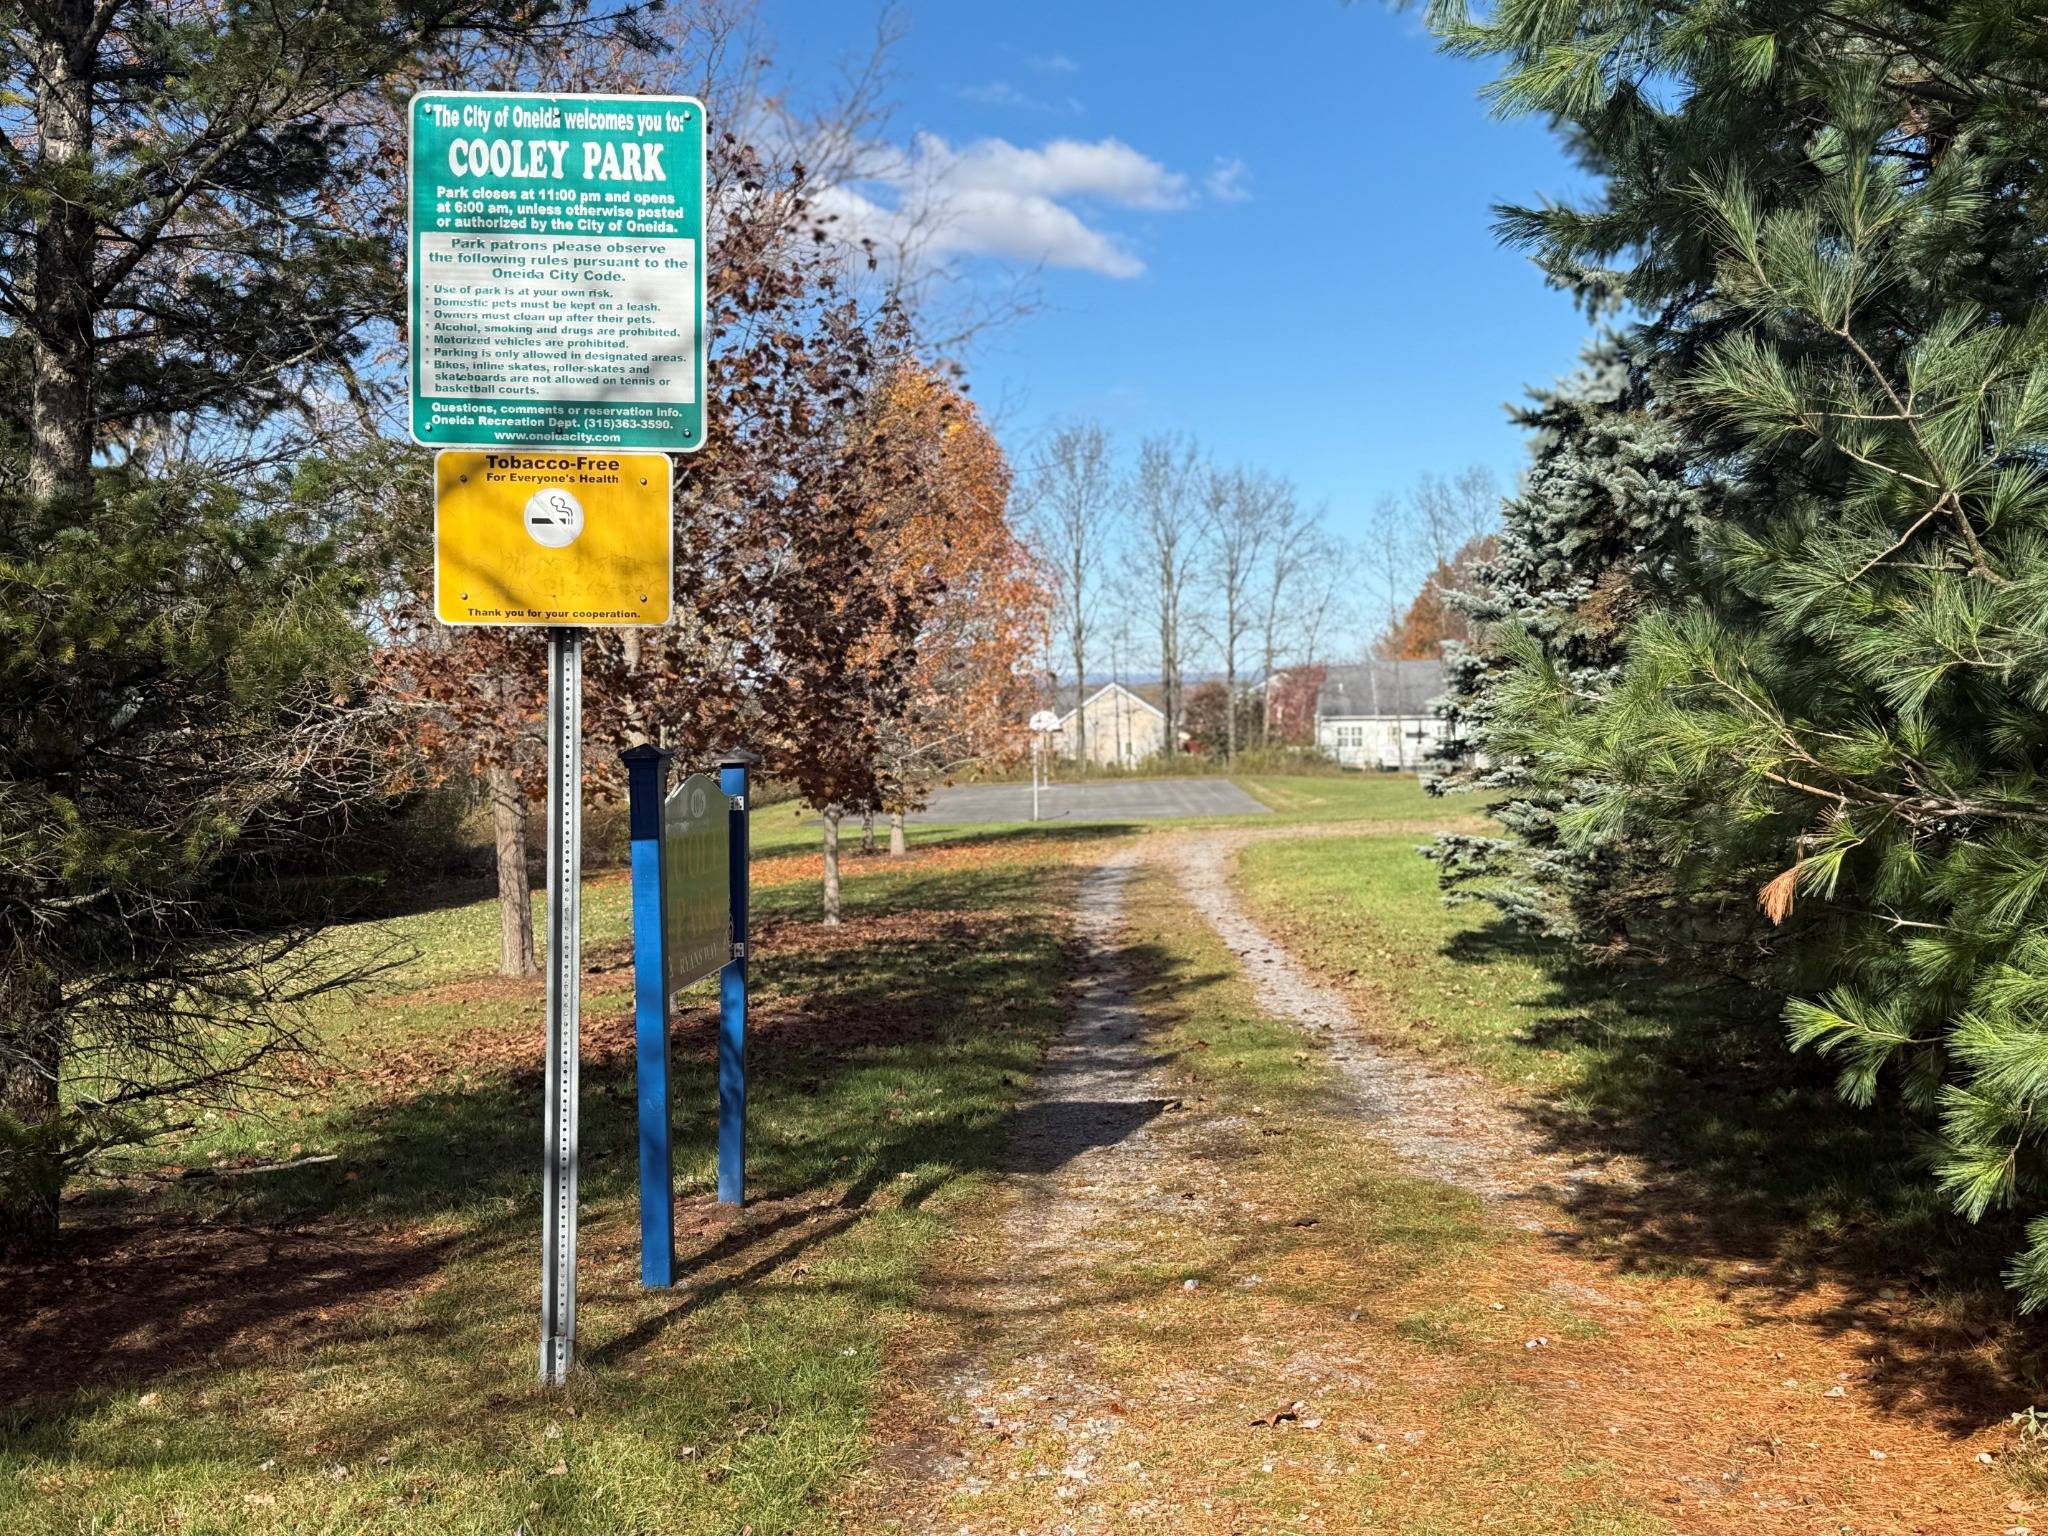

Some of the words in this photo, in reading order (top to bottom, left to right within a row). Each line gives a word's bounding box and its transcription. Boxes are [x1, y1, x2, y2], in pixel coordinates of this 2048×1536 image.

[433, 105, 459, 126] The
[463, 106, 489, 132] City
[495, 106, 508, 127] of
[565, 109, 633, 131] welcomes
[637, 113, 661, 136] you
[666, 111, 684, 132] to:
[449, 138, 570, 179] COOLEY
[583, 142, 667, 181] PARK
[436, 186, 468, 198] Park
[472, 187, 516, 200] closes
[521, 189, 535, 200] at
[539, 189, 576, 201] 11:00
[580, 192, 600, 204] pm
[605, 191, 630, 202] and
[634, 193, 675, 206] opens
[436, 202, 451, 212] at
[455, 202, 483, 213] 6:00
[488, 205, 513, 215] am,
[517, 204, 561, 215] unless
[565, 204, 633, 217] otherwise
[637, 207, 684, 220] posted
[436, 218, 451, 227] or
[455, 216, 526, 229] authorized
[530, 217, 547, 231] by
[551, 218, 574, 230] the
[577, 219, 604, 233] City
[608, 219, 622, 231] of
[626, 220, 678, 233] Oneida.
[451, 238, 485, 249] Park
[491, 241, 548, 252] patrons
[553, 241, 601, 253] please
[607, 242, 666, 253] observe
[429, 252, 453, 263] the
[457, 253, 527, 267] following
[531, 254, 568, 265] rules
[573, 257, 640, 270] pursuant
[645, 257, 659, 268] to
[663, 258, 688, 269] the
[492, 268, 545, 279] Oneida
[550, 269, 579, 282] City
[583, 270, 626, 282] Code.
[434, 285, 456, 294] Use
[460, 286, 471, 294] of
[475, 286, 500, 297] park
[505, 288, 515, 296] is
[533, 289, 557, 298] your
[589, 289, 613, 298] risk.
[434, 298, 488, 307] Domestic
[492, 300, 517, 309] pets
[521, 300, 549, 308] must
[553, 301, 566, 309] be
[570, 301, 595, 311] kept
[627, 302, 661, 311] leash.
[434, 310, 478, 319] Owners
[514, 313, 545, 321] clean
[549, 315, 562, 324] up
[566, 314, 594, 322] after
[597, 314, 623, 323] their
[627, 316, 655, 325] pets.
[434, 323, 481, 333] Alcohol,
[484, 325, 532, 334] smoking
[536, 326, 557, 334] and
[561, 327, 593, 337] drugs
[619, 328, 681, 338] prohibited.
[434, 335, 491, 345] Motorized
[494, 337, 541, 346] vehicles
[567, 338, 629, 349] prohibited.
[434, 348, 478, 359] Parking
[482, 350, 492, 358] is
[495, 350, 519, 360] only
[523, 350, 567, 360] allowed
[571, 351, 581, 360] in
[585, 352, 648, 363] designated
[652, 354, 686, 363] areas.
[434, 361, 469, 370] Bikes,
[473, 362, 504, 370] inline
[508, 363, 550, 373] skates,
[554, 364, 625, 373] roller-skates
[629, 365, 650, 374] and
[435, 373, 506, 382] skateboards
[510, 375, 528, 383] are
[532, 375, 551, 383] not
[555, 375, 599, 385] allowed
[620, 377, 655, 386] tennis
[659, 378, 671, 386] or
[435, 384, 495, 394] basketball
[498, 386, 539, 395] courts.
[432, 402, 496, 415] Questions,
[501, 404, 564, 415] comments
[568, 407, 580, 415] or
[584, 407, 652, 417] reservation
[656, 408, 682, 418] info.
[432, 415, 474, 426] Oneida
[478, 416, 545, 427] Recreation
[549, 418, 581, 429] Dept.
[584, 419, 674, 430] (315)363-3590.
[486, 456, 620, 470] Tobacco-Free
[486, 473, 506, 482] For
[510, 473, 575, 484] Everyone's
[579, 474, 619, 483] Health
[468, 608, 501, 617] Thank
[505, 610, 524, 618] you
[528, 609, 542, 617] for
[546, 610, 569, 619] your
[572, 610, 640, 619] cooperation.
